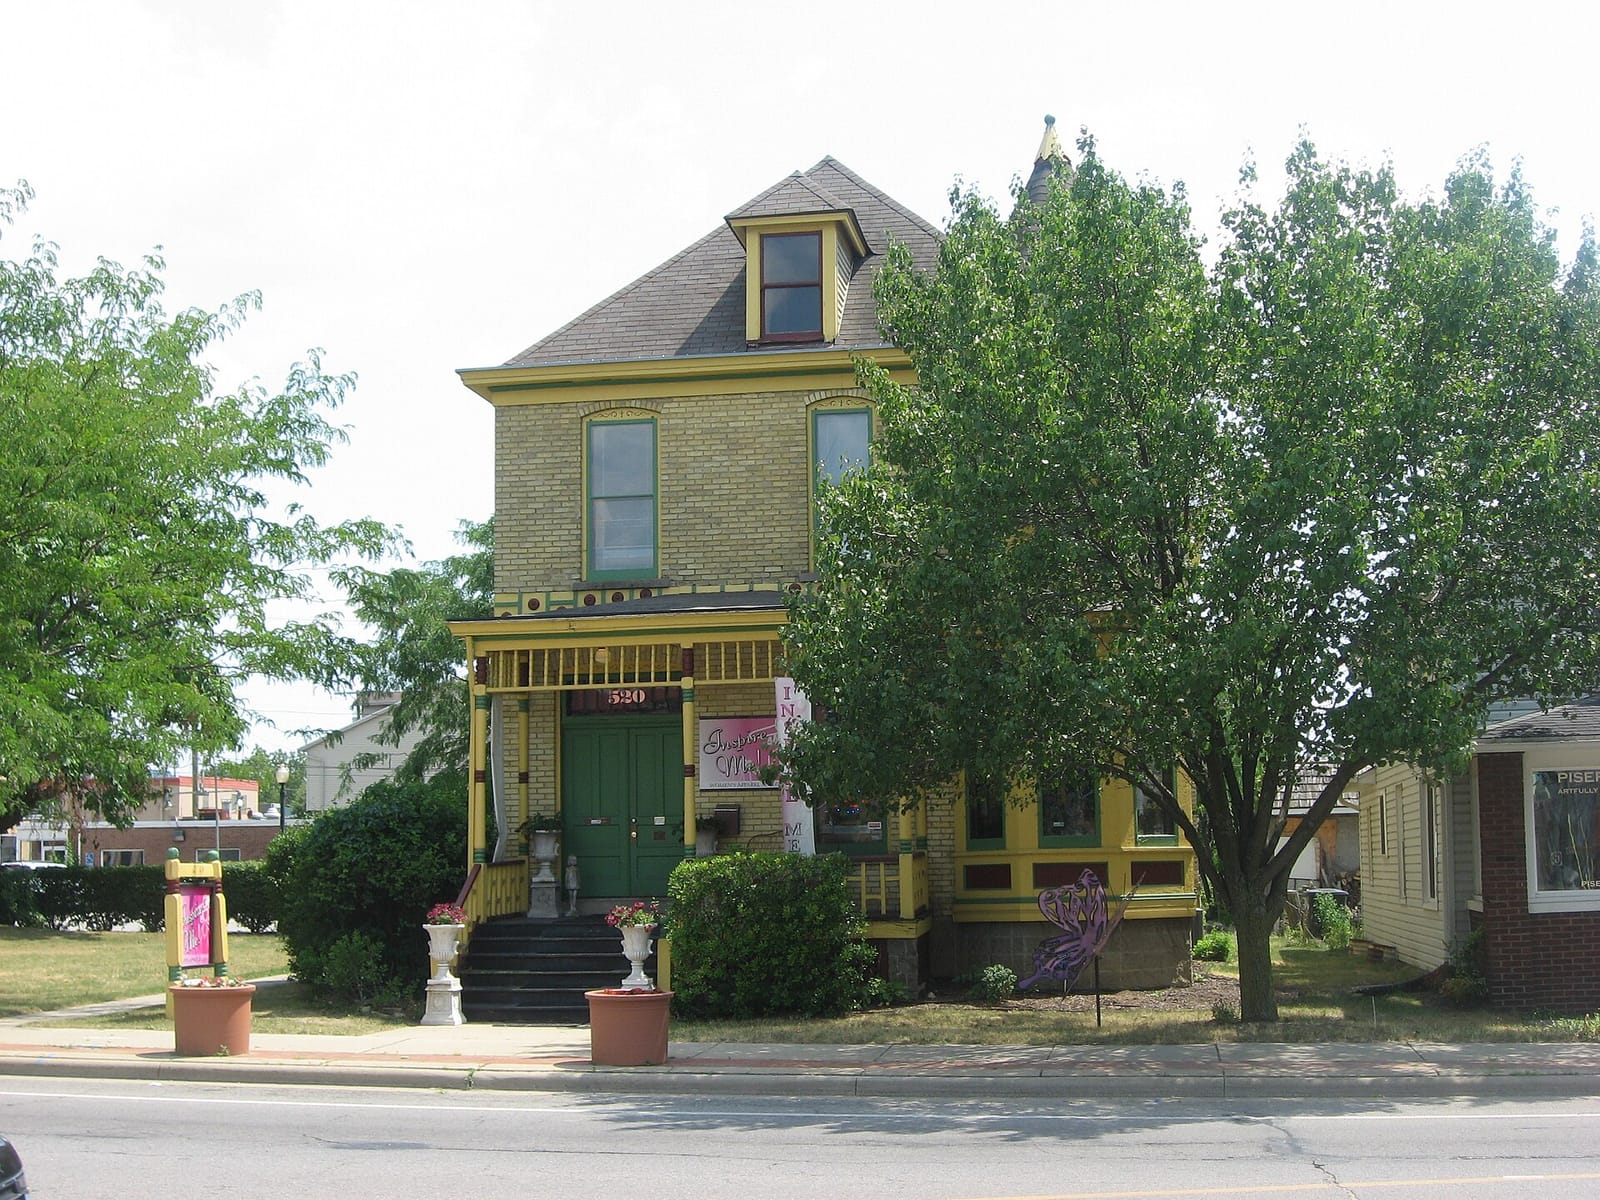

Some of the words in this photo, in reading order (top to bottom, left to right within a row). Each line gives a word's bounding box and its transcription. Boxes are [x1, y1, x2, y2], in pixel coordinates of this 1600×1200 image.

[608, 689, 646, 704] 520
[703, 728, 768, 754] Inspire
[1557, 787, 1599, 795] ARTFULLY
